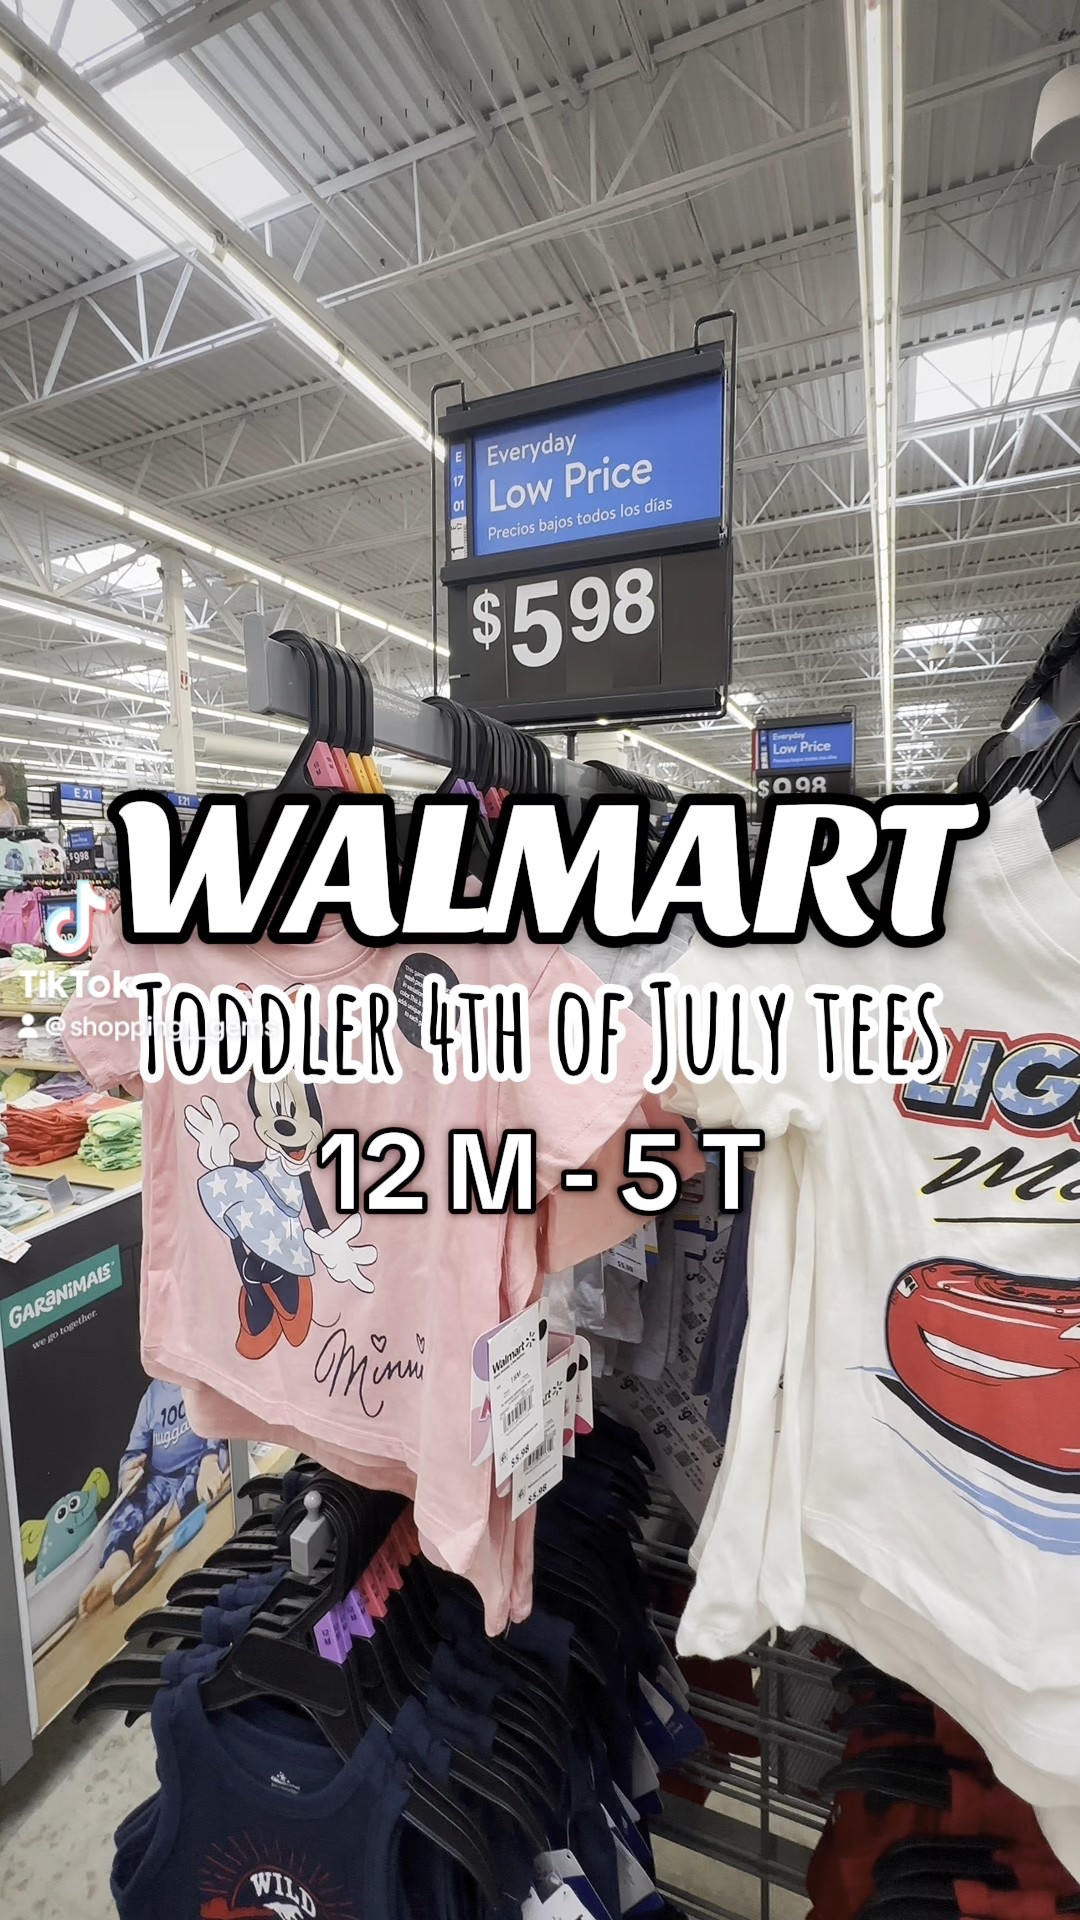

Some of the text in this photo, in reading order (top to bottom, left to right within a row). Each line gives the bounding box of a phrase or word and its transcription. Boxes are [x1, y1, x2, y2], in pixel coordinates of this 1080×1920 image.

[455, 451, 463, 463] E
[488, 433, 576, 466] Everyday
[453, 475, 464, 487] 17
[489, 456, 653, 513] Low Price
[453, 500, 464, 512] 01
[487, 522, 535, 541] Precios
[539, 516, 573, 534] bajos
[576, 508, 616, 526] todos
[620, 503, 641, 518] los
[644, 497, 673, 514] días
[772, 732, 806, 742] Everyday
[773, 741, 832, 755] Low Price
[74, 788, 93, 800] E 21
[897, 1030, 1080, 1137] LIG
[32, 1309, 98, 1350] we go together.
[314, 1328, 425, 1418] Minni
[492, 1341, 525, 1374] Walmart
[250, 1871, 317, 1918] WILD
